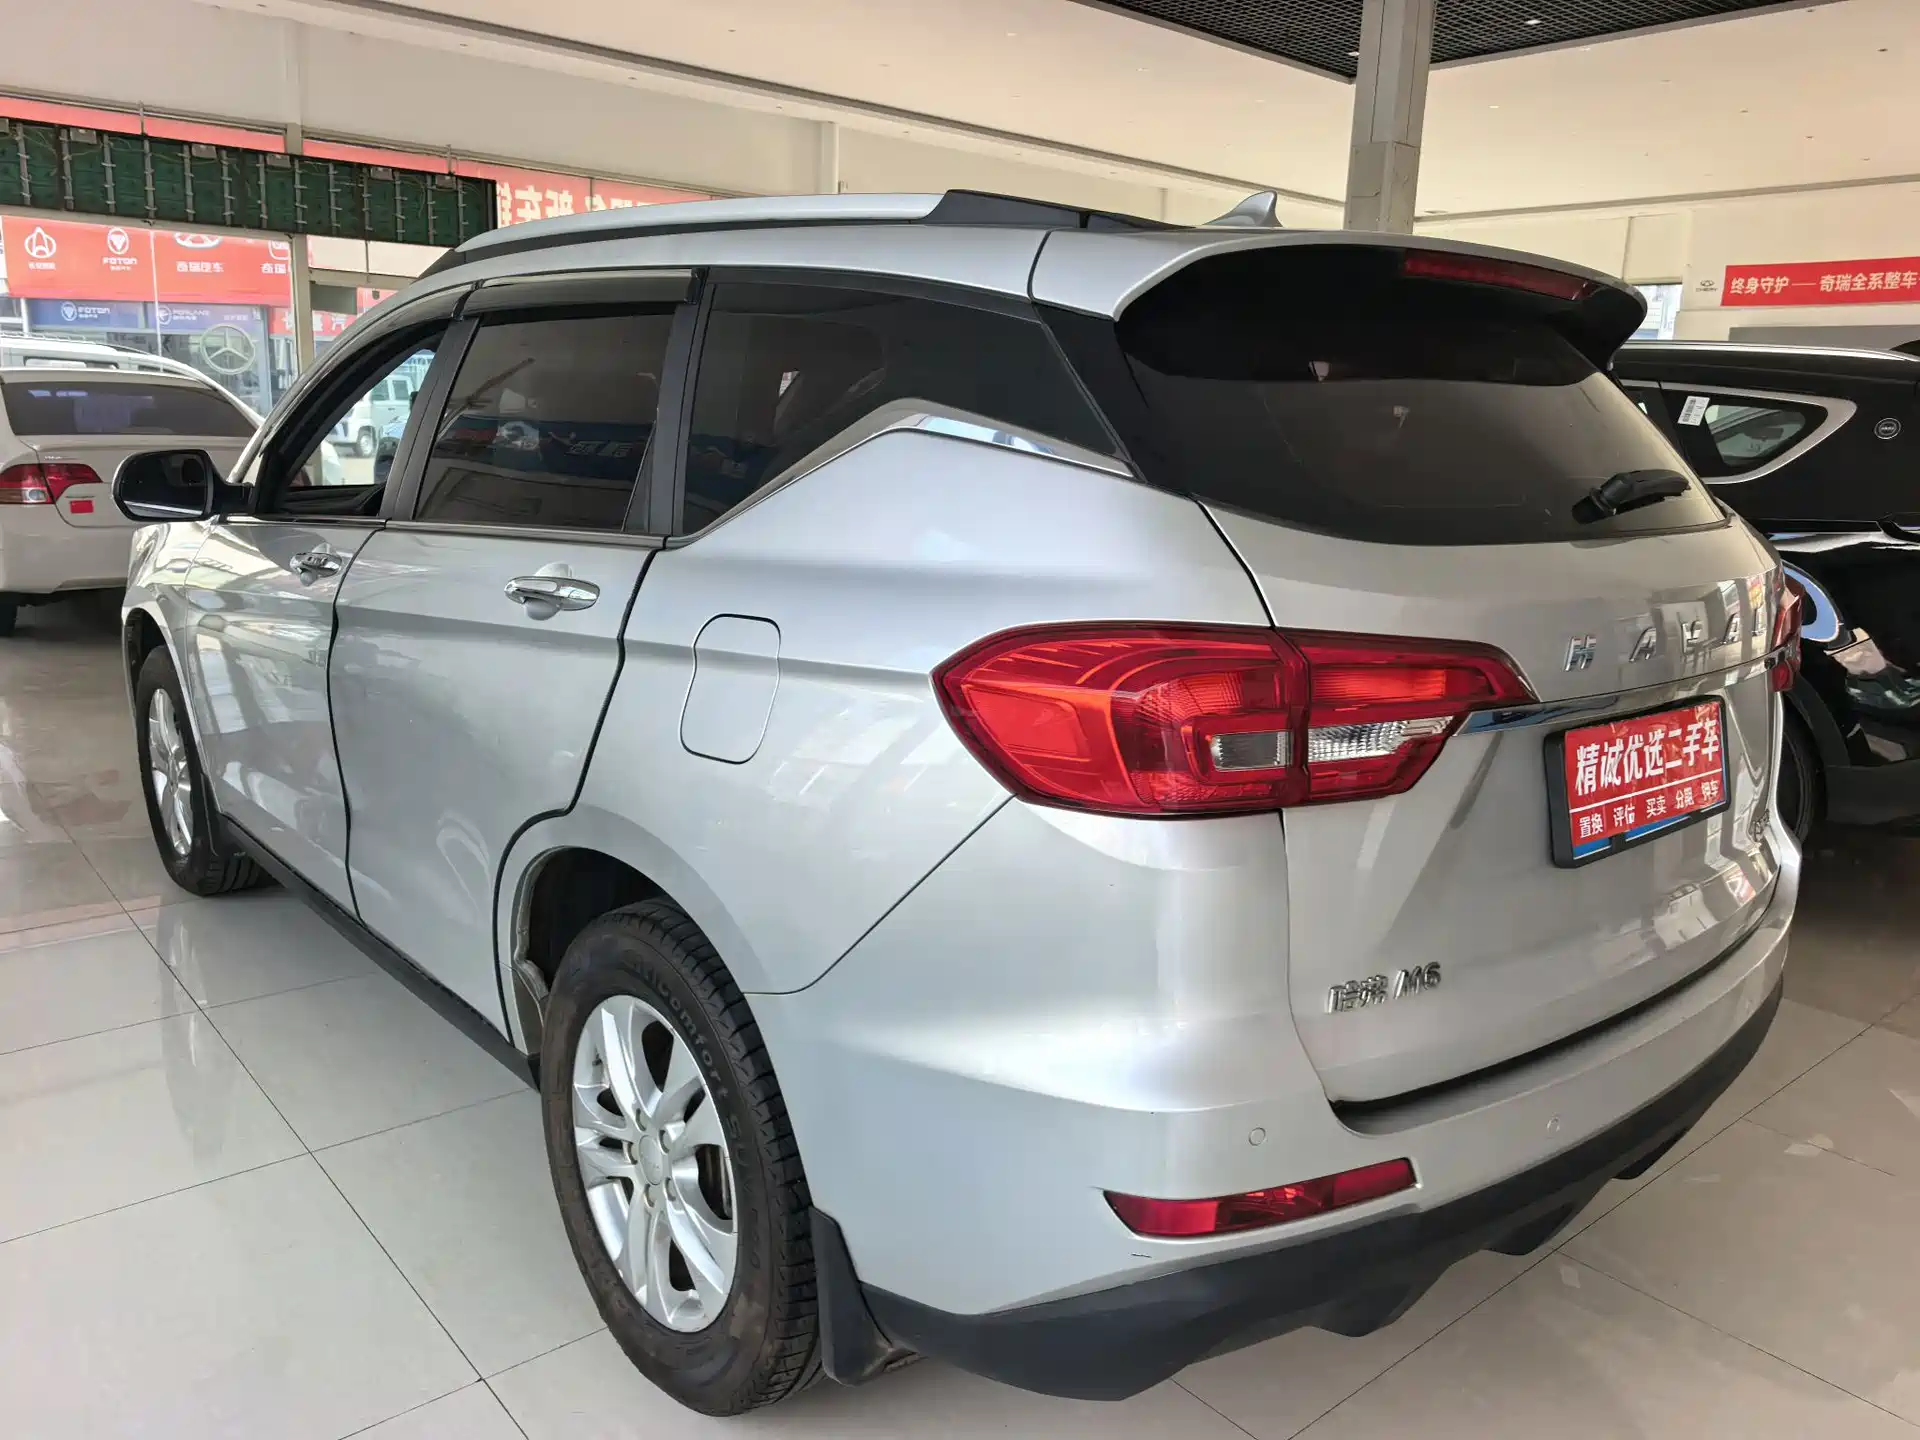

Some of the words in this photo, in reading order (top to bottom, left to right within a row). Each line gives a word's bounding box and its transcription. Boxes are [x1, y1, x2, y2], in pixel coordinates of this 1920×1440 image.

[261, 262, 290, 274] 奇瑞
[1575, 718, 1720, 796] 精诚优选二手车
[1579, 813, 1604, 839] 置换
[1613, 804, 1636, 828] 评估
[1645, 795, 1667, 819] 买卖
[1393, 961, 1442, 1000] M6
